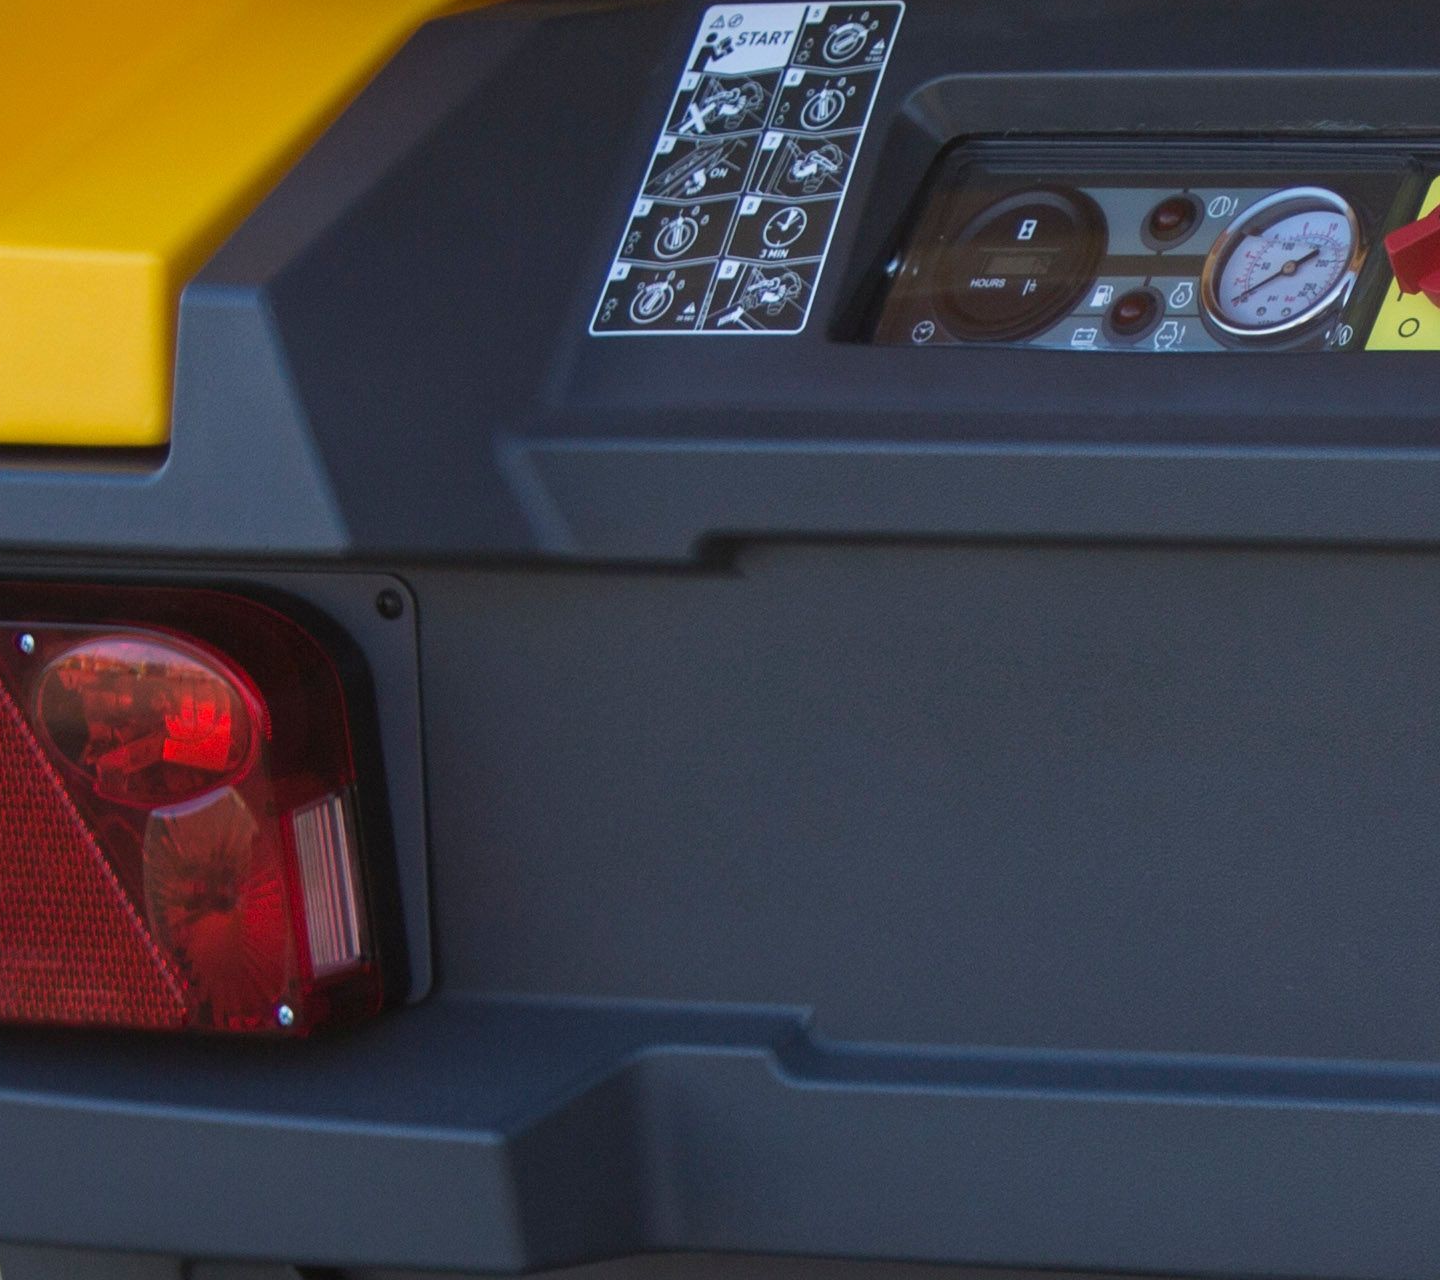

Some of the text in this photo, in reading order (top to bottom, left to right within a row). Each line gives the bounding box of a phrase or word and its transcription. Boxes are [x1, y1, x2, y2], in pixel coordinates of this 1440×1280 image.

[735, 30, 794, 47] START
[710, 167, 729, 178] ON
[759, 248, 789, 259] 3 MIN
[969, 278, 1007, 289] HOURS
